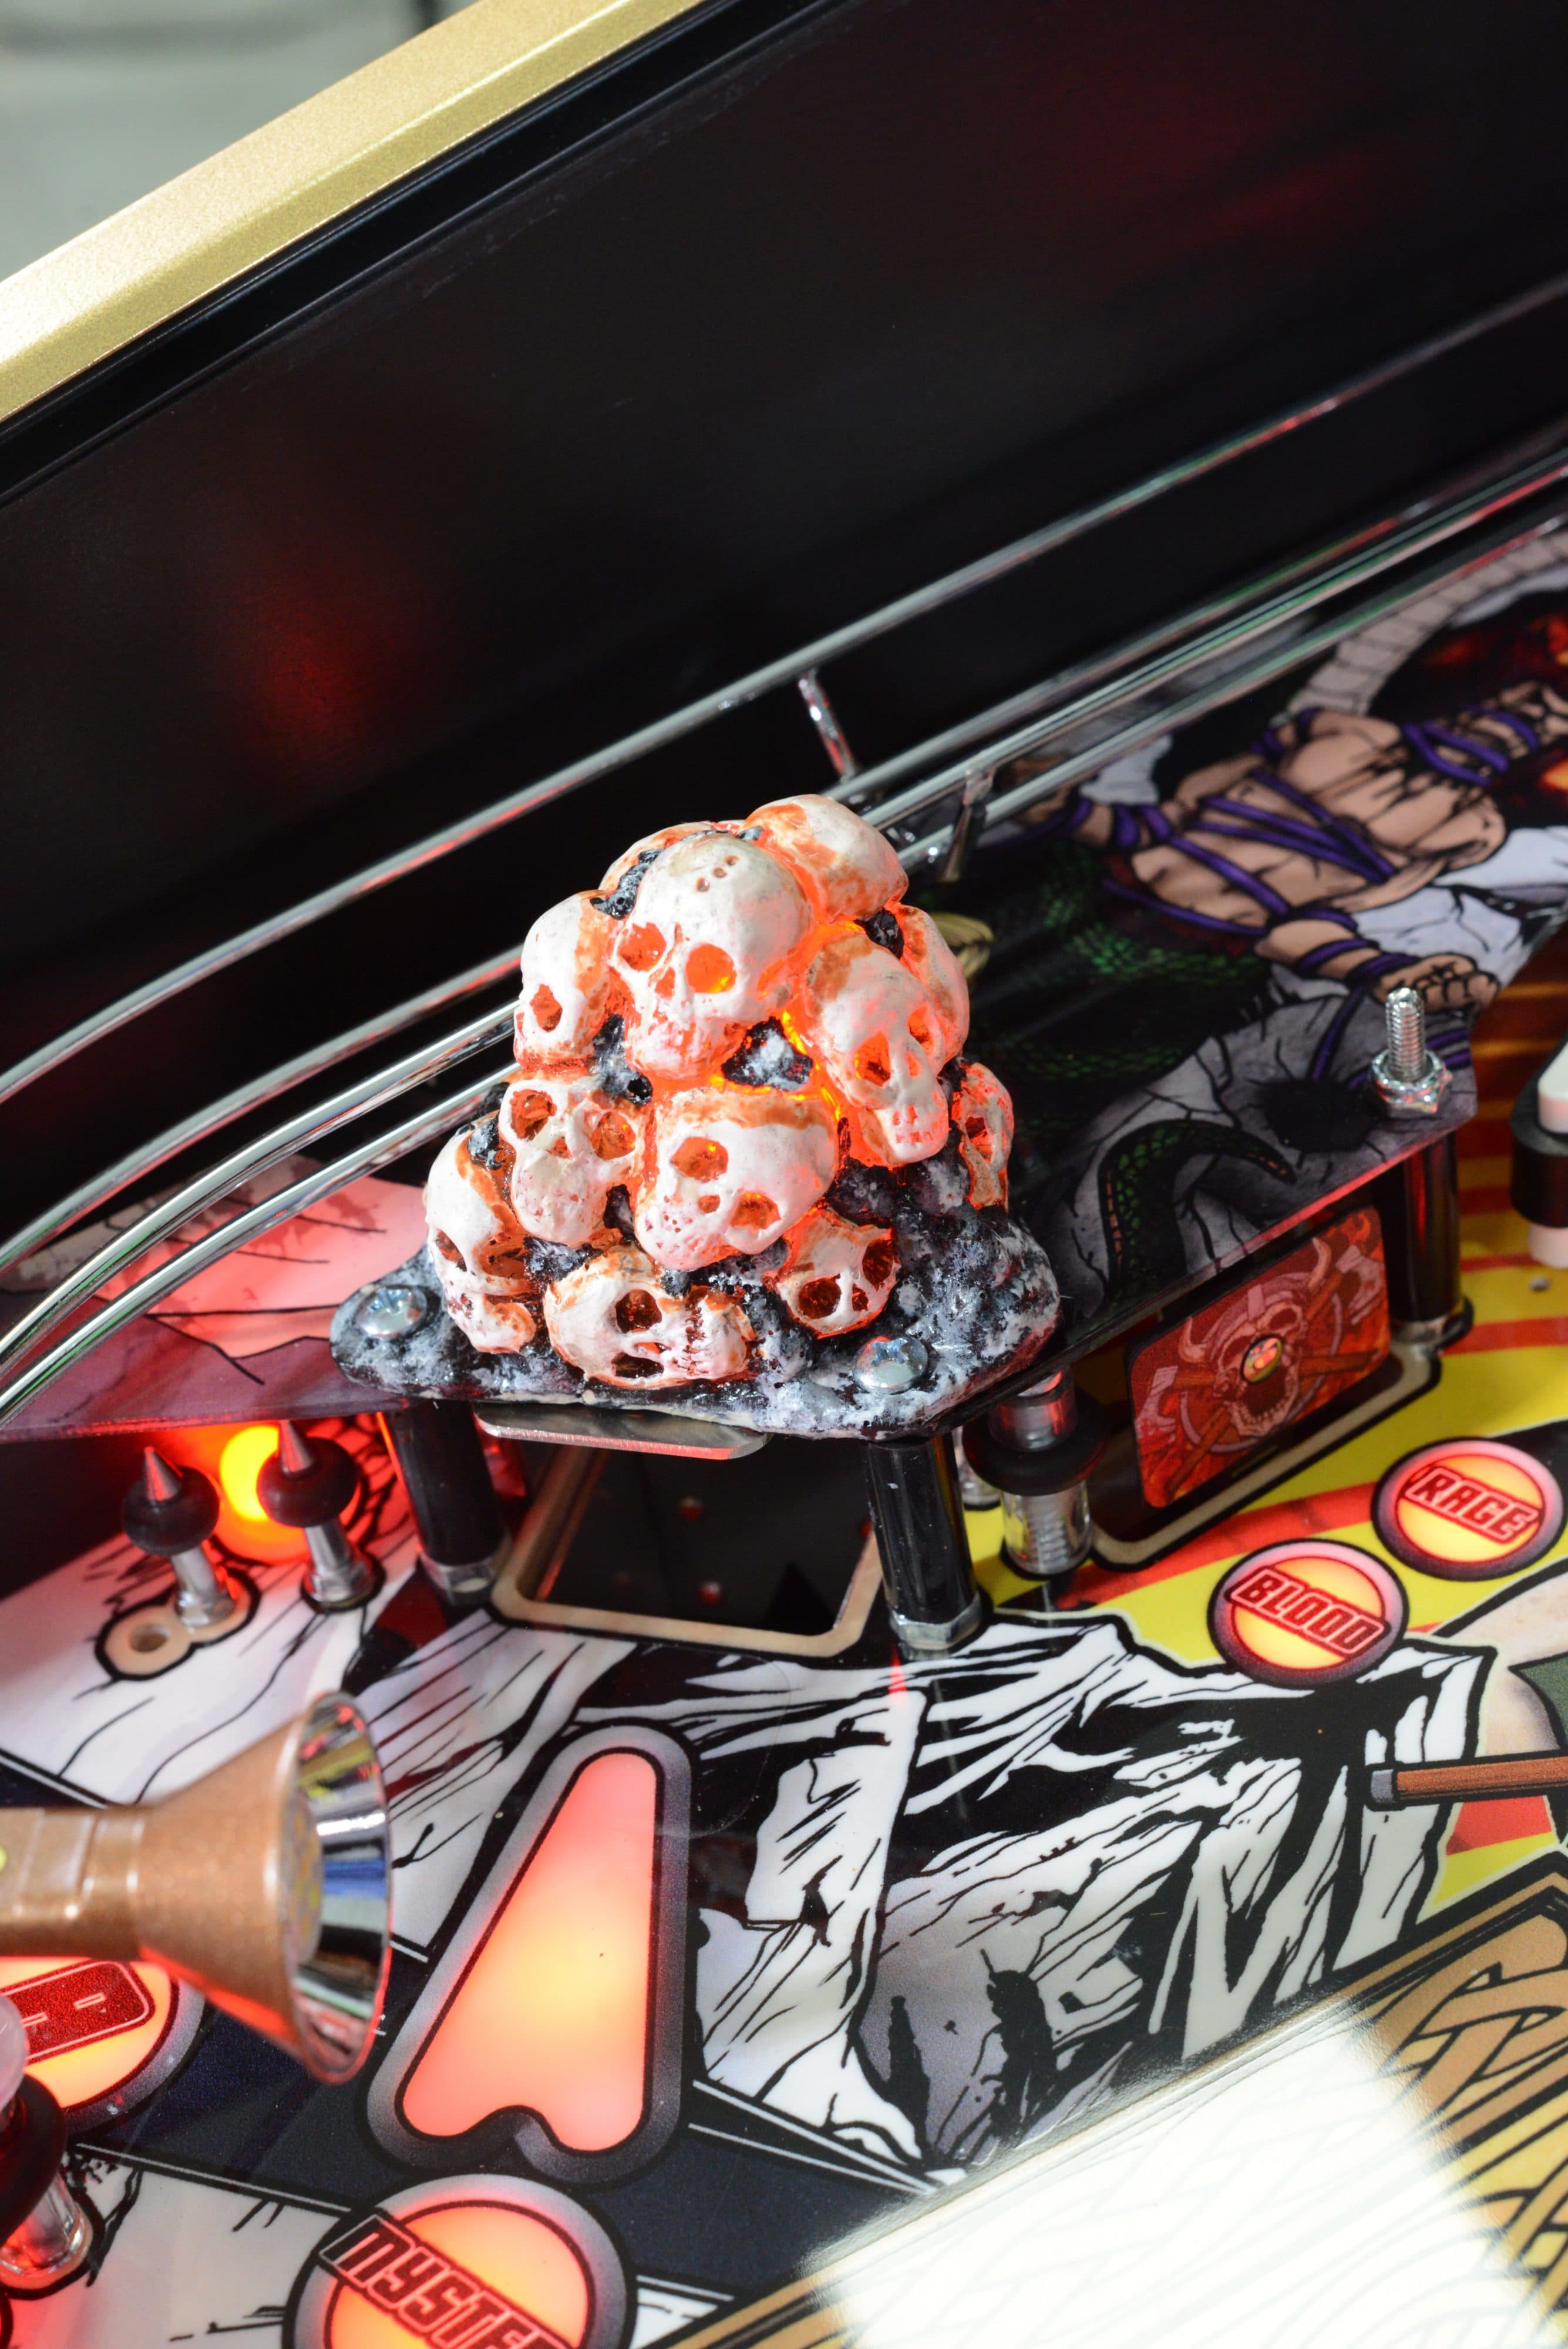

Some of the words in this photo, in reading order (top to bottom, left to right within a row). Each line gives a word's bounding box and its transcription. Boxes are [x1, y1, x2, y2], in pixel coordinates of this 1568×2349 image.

[1406, 1466, 1537, 1544] RAGE
[1231, 1567, 1385, 1653] BLOOD
[320, 2215, 565, 2348] MYSTE
